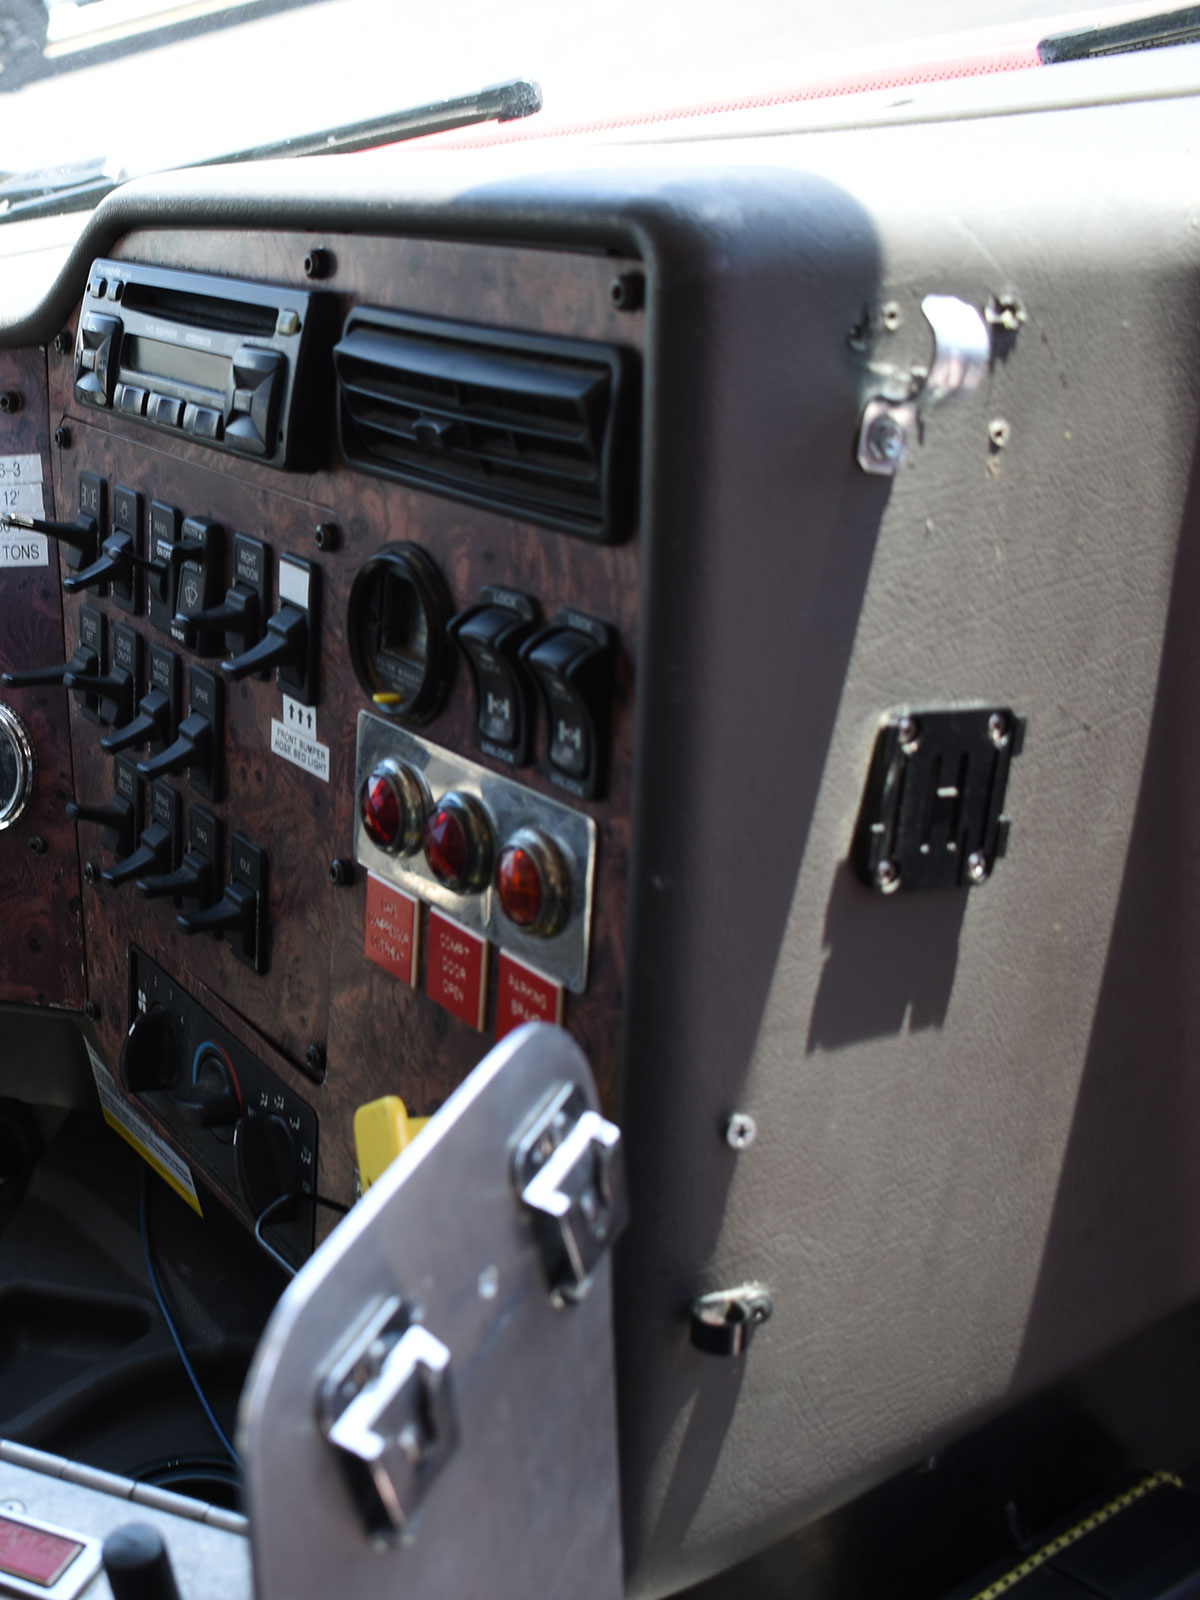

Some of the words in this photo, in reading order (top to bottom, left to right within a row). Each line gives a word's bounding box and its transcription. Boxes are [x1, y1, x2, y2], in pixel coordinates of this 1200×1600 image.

[4, 490, 20, 506] 12'
[3, 544, 40, 561] TONS
[240, 550, 257, 567] RIGHT
[237, 564, 260, 584] WINDOW
[153, 657, 170, 675] HEATED
[276, 728, 297, 745] FRONT
[299, 739, 326, 760] BUMPER
[274, 739, 292, 756] HOSE
[293, 749, 306, 764] BED
[307, 757, 326, 774] LIGHT
[442, 954, 467, 981] DOOR
[443, 978, 465, 1004] OPEN
